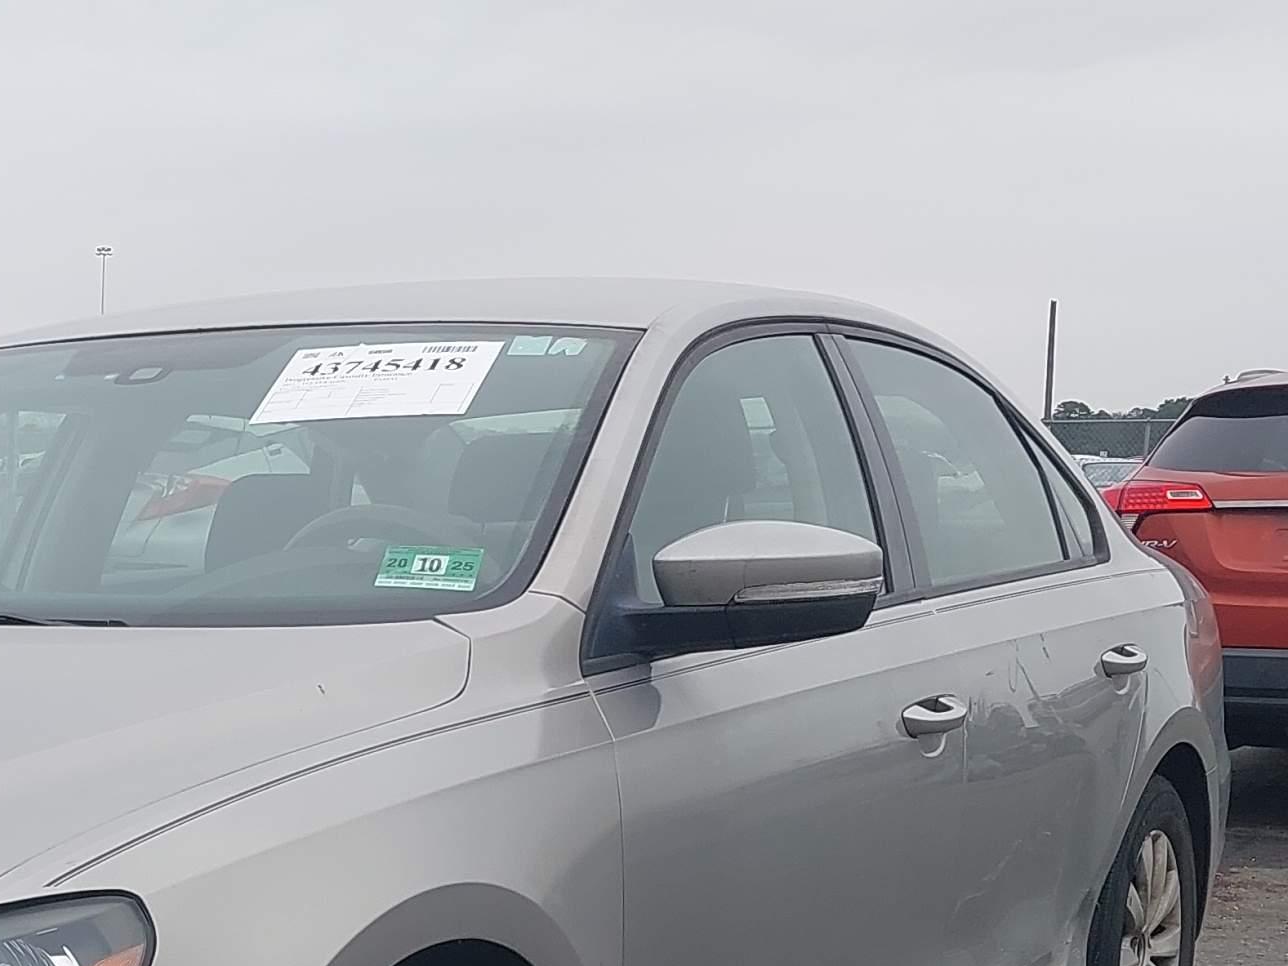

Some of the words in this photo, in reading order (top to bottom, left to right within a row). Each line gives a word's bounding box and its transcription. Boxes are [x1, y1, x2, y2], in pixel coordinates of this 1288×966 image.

[302, 357, 467, 376] 43745418
[387, 558, 408, 568] 20
[416, 557, 443, 573] 10
[451, 560, 474, 571] 25
